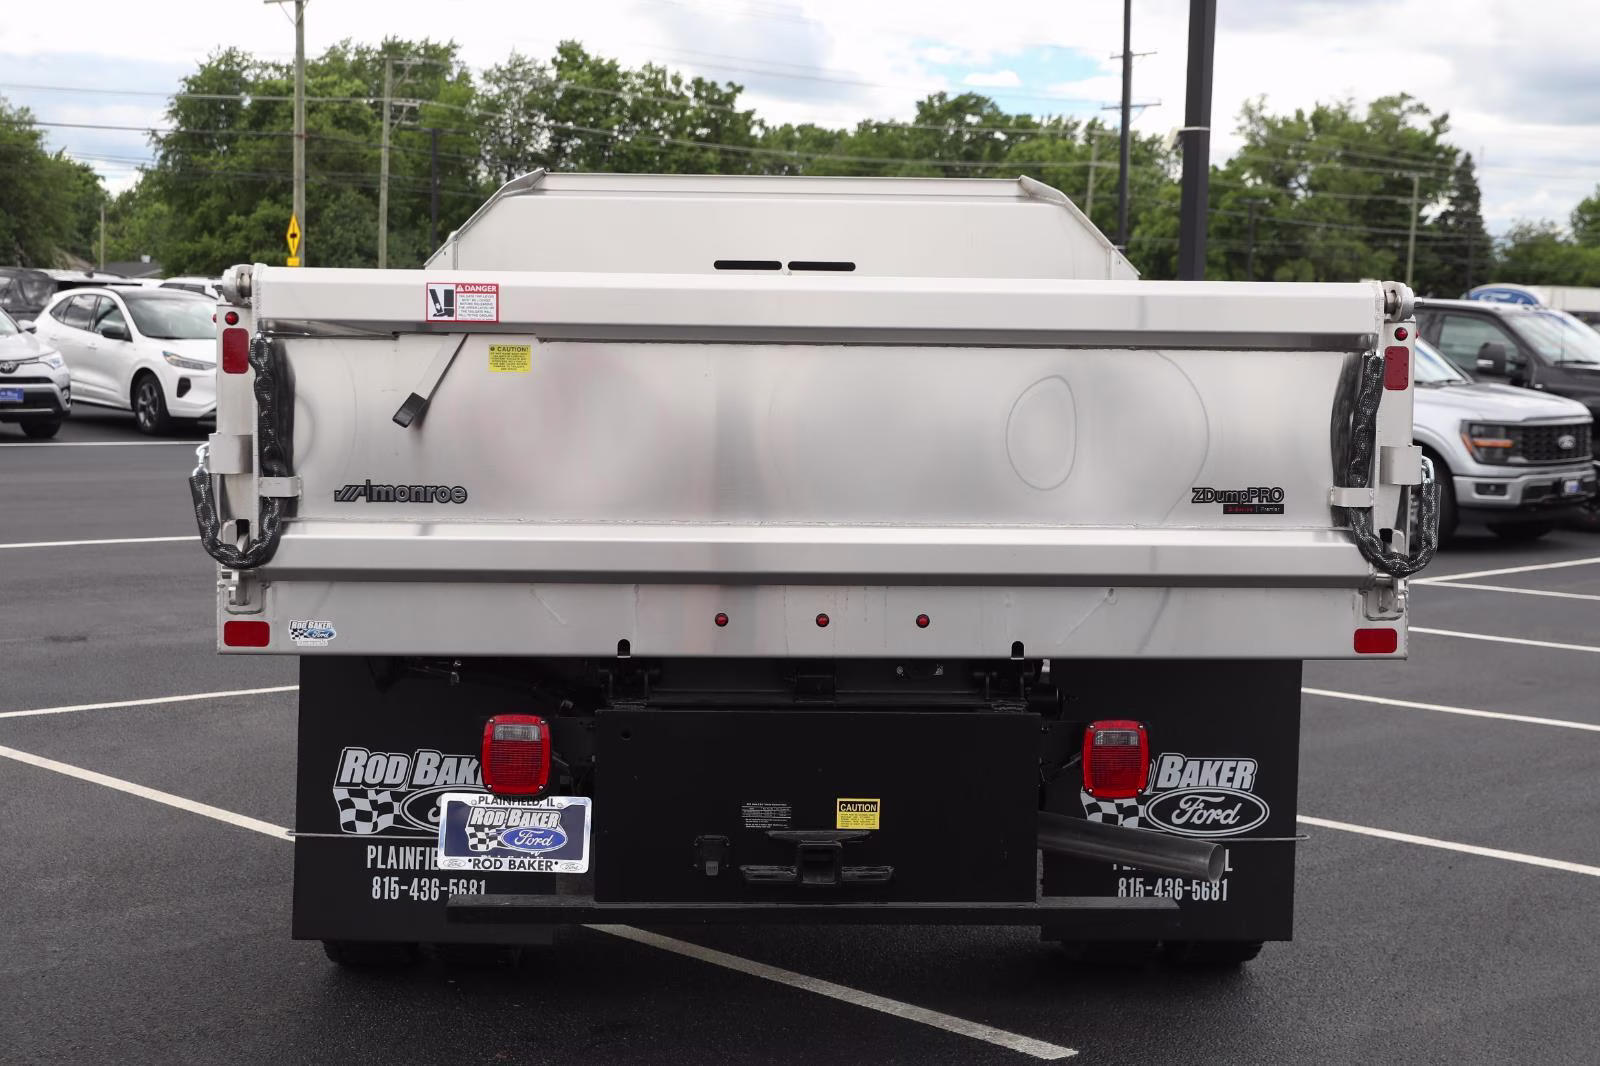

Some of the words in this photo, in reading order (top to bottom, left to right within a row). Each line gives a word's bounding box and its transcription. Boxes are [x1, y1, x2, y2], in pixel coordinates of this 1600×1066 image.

[371, 484, 468, 504] monroe
[1191, 487, 1285, 504] ZDumpPRO
[339, 749, 409, 785] ROD
[412, 751, 483, 785] BAK
[1156, 755, 1254, 789] BAKER
[470, 807, 506, 826] ROD
[507, 807, 560, 828] BAKER
[840, 803, 877, 812] CAUTION
[1171, 794, 1243, 825] Ford
[514, 829, 553, 846] Ford
[367, 845, 440, 870] PLAINFIE
[472, 858, 503, 870] ROD
[509, 859, 553, 872] BAKER
[372, 876, 486, 901] 815-436-5681
[1118, 877, 1229, 902] 815-436-5681
